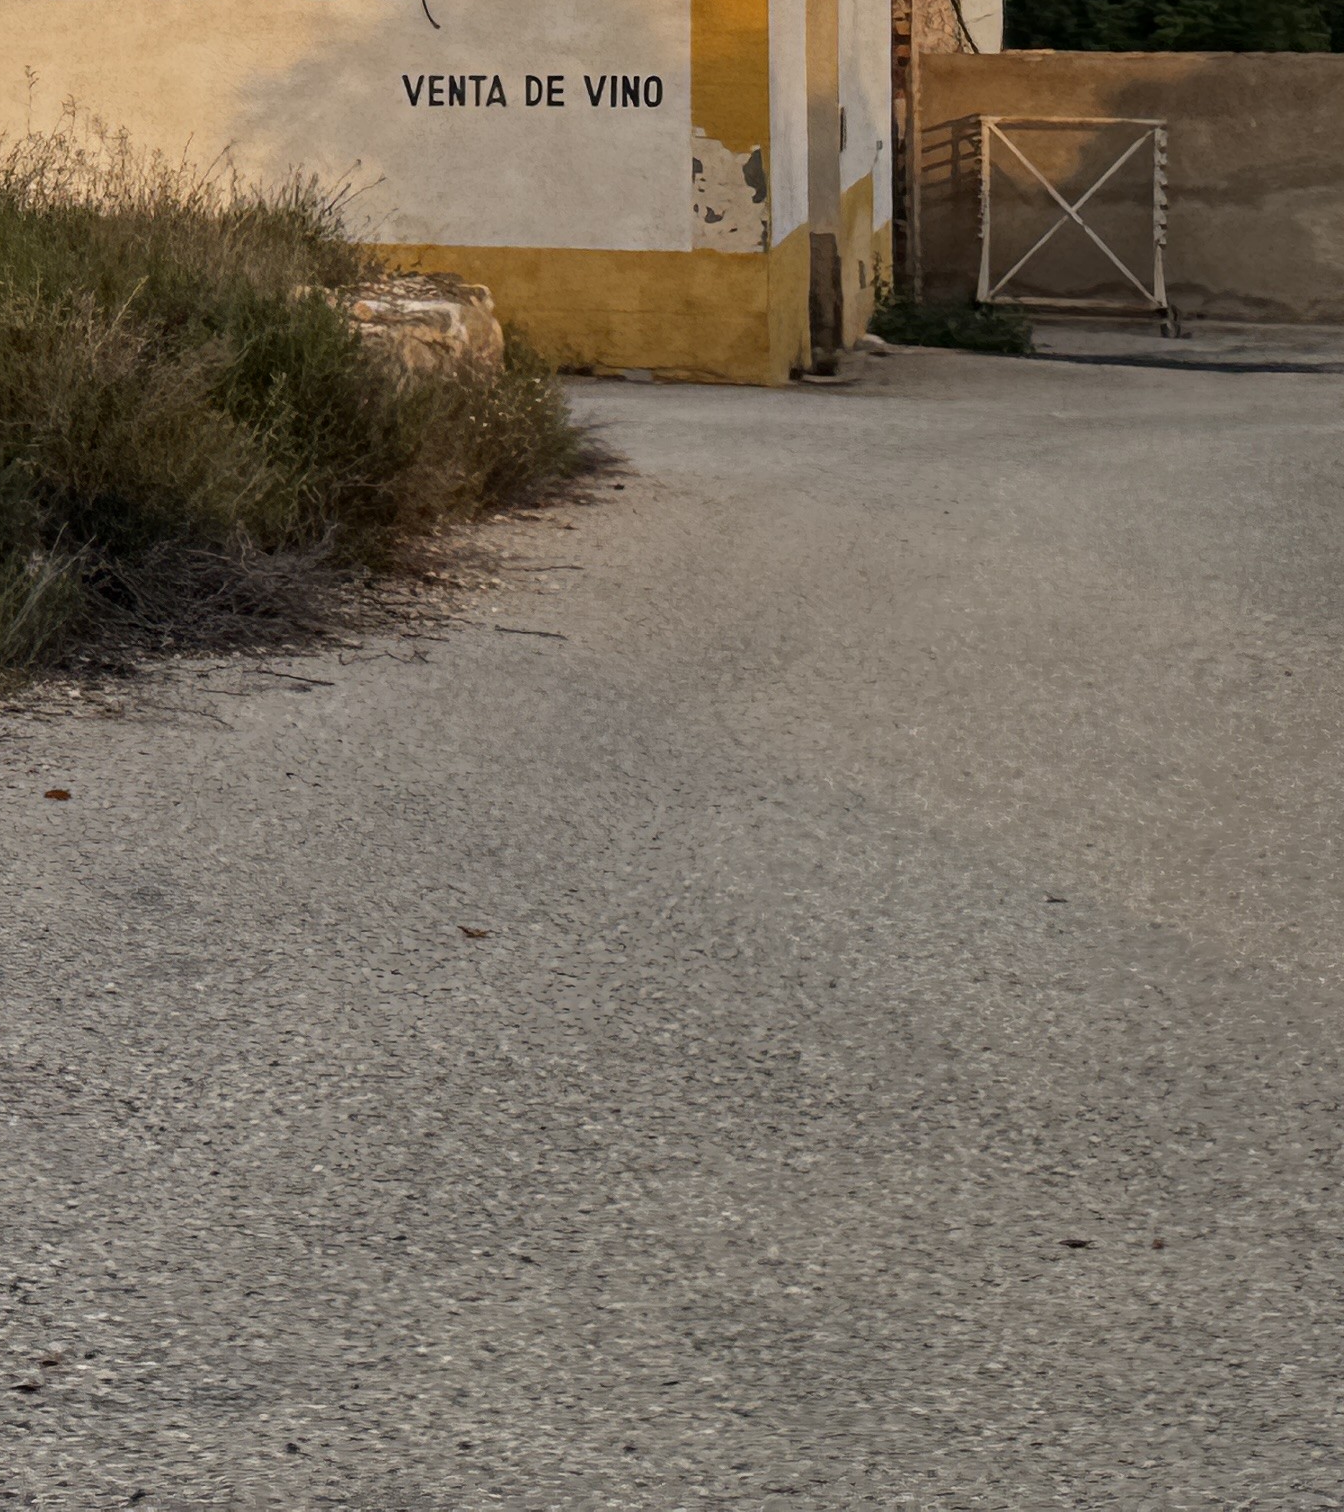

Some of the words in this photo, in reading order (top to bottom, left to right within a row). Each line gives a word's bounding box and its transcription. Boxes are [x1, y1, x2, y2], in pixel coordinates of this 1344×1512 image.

[402, 74, 507, 107] VENTA
[525, 75, 565, 107] DE
[583, 75, 663, 108] VINO
